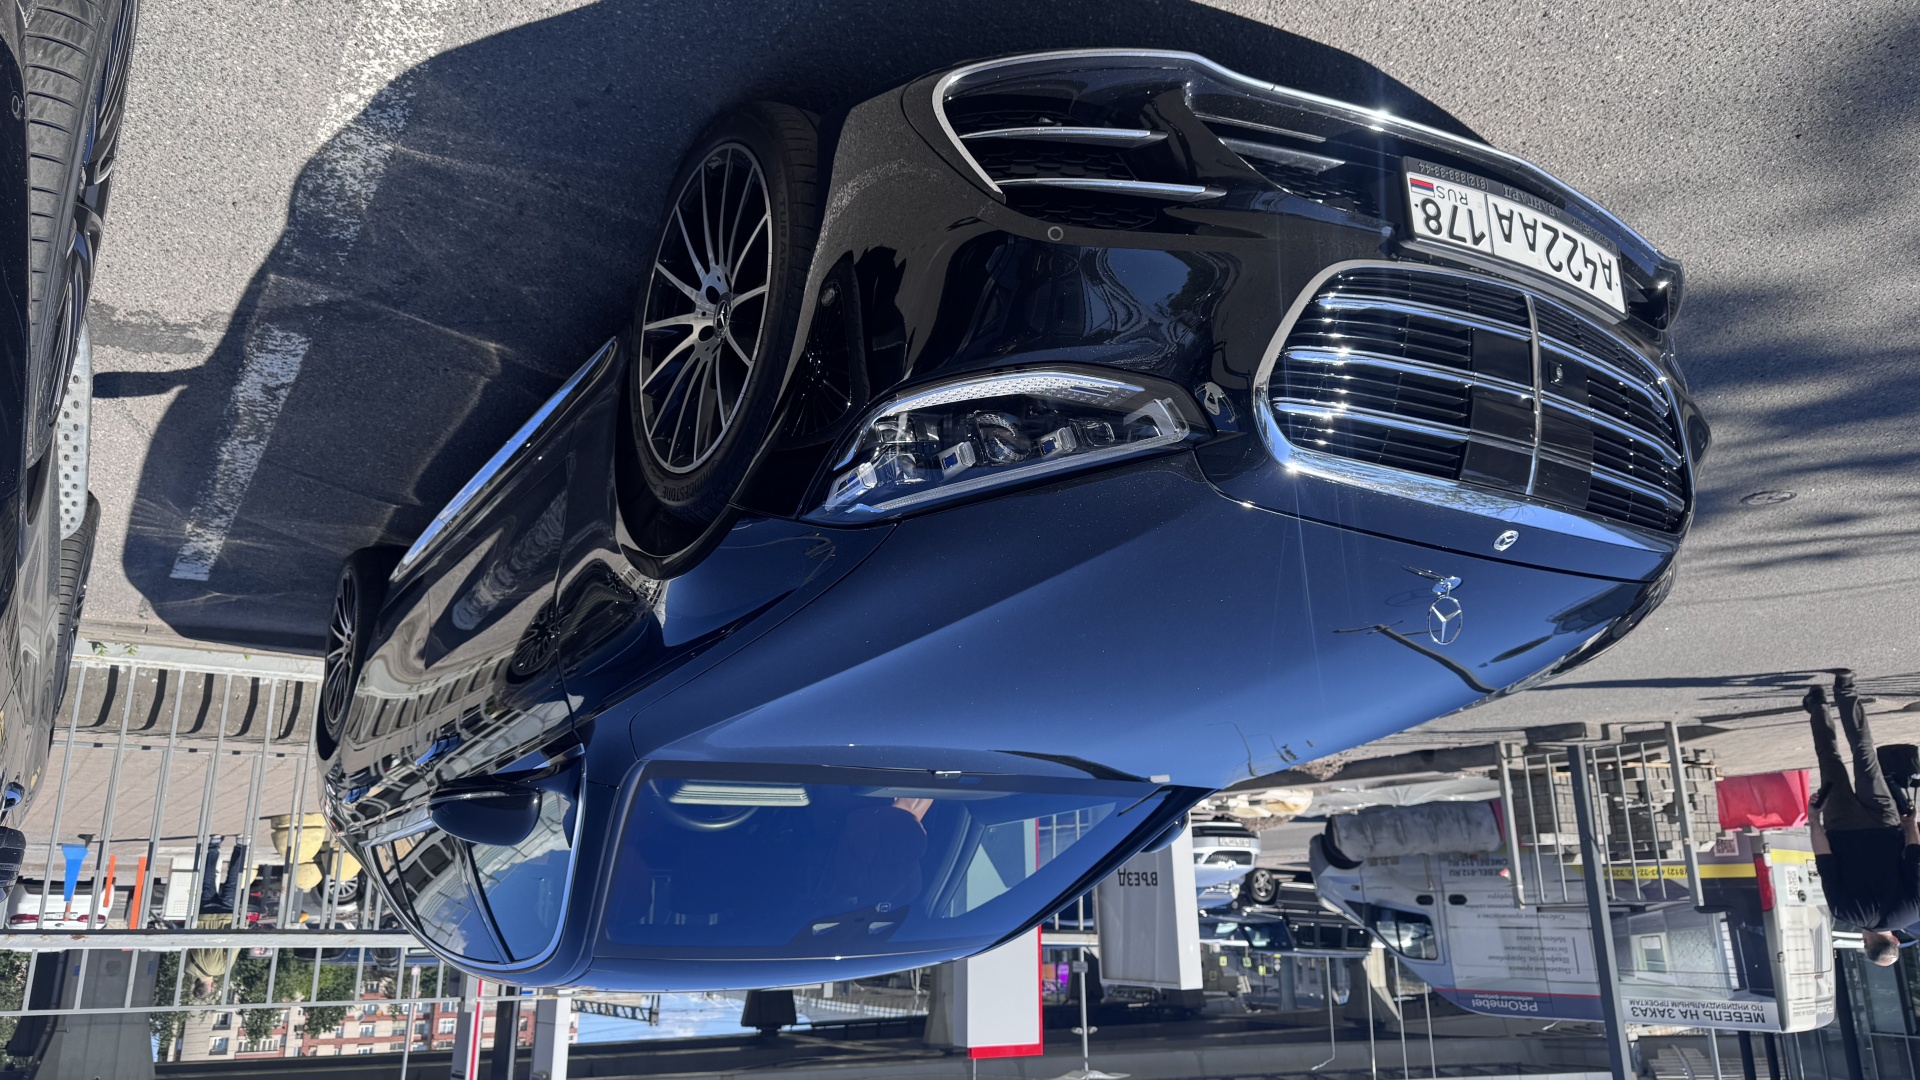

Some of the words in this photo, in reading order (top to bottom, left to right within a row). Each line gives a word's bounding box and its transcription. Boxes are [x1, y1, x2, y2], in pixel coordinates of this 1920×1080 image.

[1418, 162, 1489, 191] (812)333-33-44
[1436, 186, 1468, 205] RUS
[1502, 184, 1561, 219] АВАНГАРД
[1421, 198, 1486, 246] 178
[1117, 868, 1158, 886] ВЪЕЗД
[1471, 998, 1538, 1012] PROmebel
[1629, 999, 1669, 1007] ПРОЕКТАМ
[1671, 1001, 1749, 1011] ИНДИВИДУАЛЬНЫМ
[1751, 1004, 1763, 1012] ПО
[1630, 1006, 1676, 1019] ЗАКАЗ
[1678, 1008, 1699, 1020] НА
[1703, 1010, 1765, 1024] МЕБЕЛЬ
